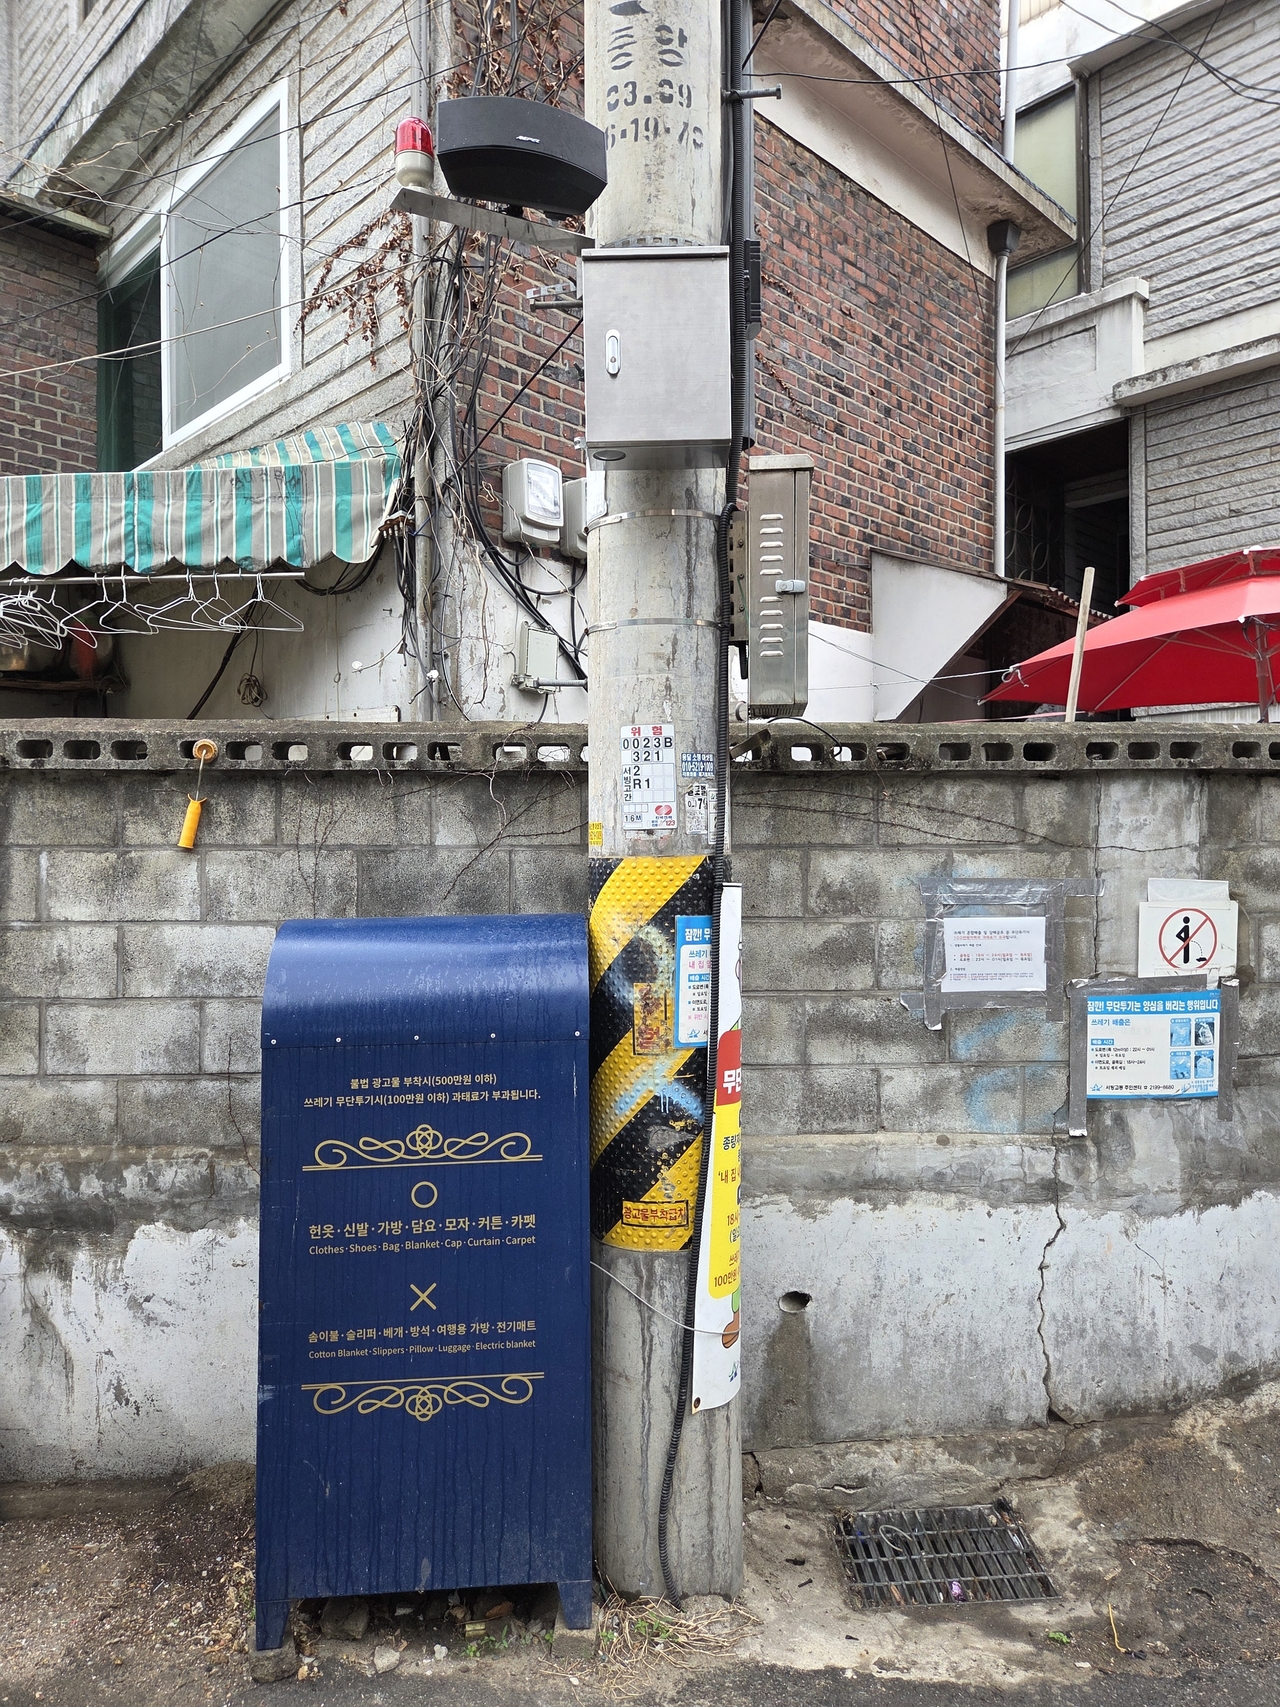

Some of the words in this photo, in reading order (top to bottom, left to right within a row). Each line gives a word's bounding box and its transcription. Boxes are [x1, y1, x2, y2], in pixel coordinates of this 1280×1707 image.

[689, 950, 708, 958] 쓰레기
[1106, 1000, 1141, 1011] 무단투기는
[1165, 999, 1186, 1011] 버리는
[1187, 999, 1219, 1010] 행위입니다
[350, 1078, 369, 1089] 불법
[372, 1077, 400, 1088] 광고물
[403, 1074, 472, 1087] 부착시(500만원
[475, 1074, 497, 1085] 이하)
[304, 1097, 333, 1107] 쓰레기
[336, 1093, 424, 1107] 무단투기시(100만원
[427, 1092, 449, 1104] 이하)
[452, 1090, 489, 1102] 과태료가
[492, 1089, 541, 1101] 부과됩니다.
[309, 1350, 336, 1359] Cotton
[506, 1340, 536, 1349] blanket
